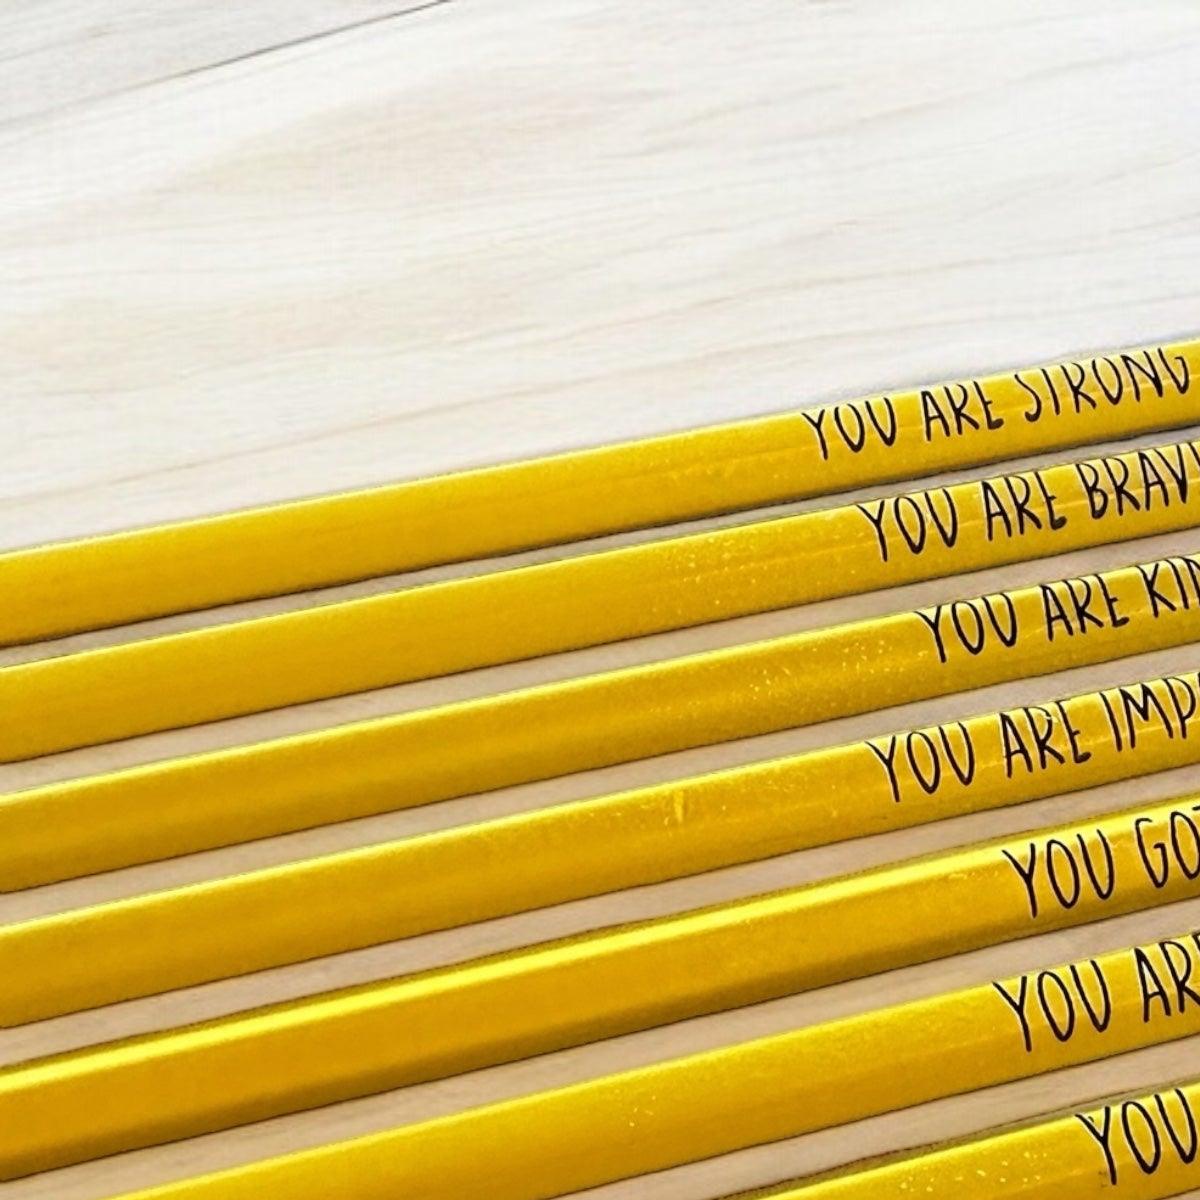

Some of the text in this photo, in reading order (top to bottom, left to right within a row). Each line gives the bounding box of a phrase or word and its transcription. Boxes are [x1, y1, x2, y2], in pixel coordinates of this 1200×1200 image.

[803, 347, 1190, 460] YOU ARE STRONG
[857, 488, 958, 562] YOU
[981, 471, 1066, 541] ARE
[914, 592, 1018, 664] YOU
[1040, 573, 1129, 642] ARE
[866, 730, 975, 803] YOU
[999, 706, 1092, 778] ARE
[1003, 829, 1115, 919] YOU
[992, 960, 1111, 1053] YOU
[1075, 1089, 1198, 1186] YOU
